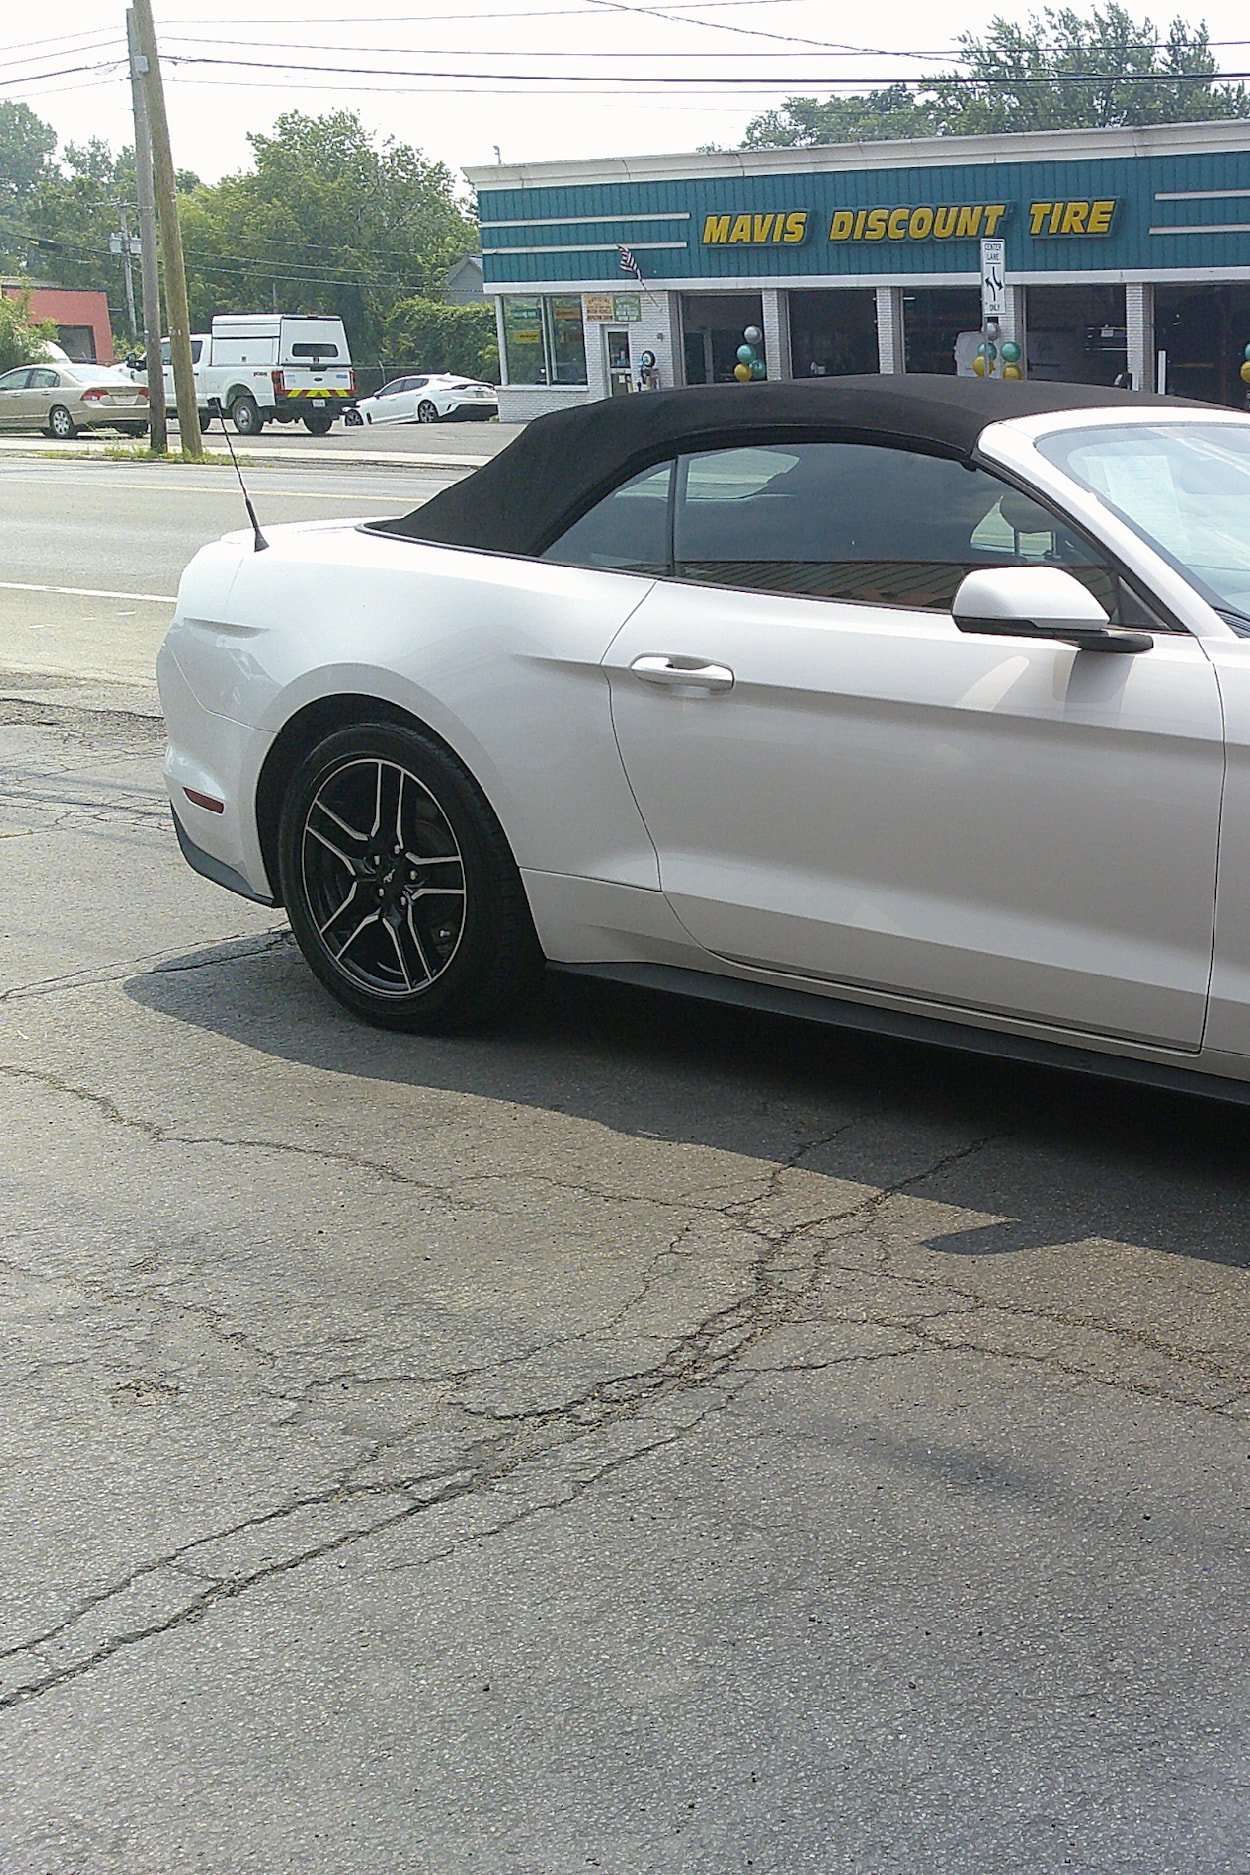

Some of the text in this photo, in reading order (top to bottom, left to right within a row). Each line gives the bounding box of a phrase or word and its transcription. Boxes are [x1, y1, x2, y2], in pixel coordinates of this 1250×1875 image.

[702, 201, 1116, 244] MAVIS DISCOUNT TIRE
[987, 253, 1000, 261] LANE
